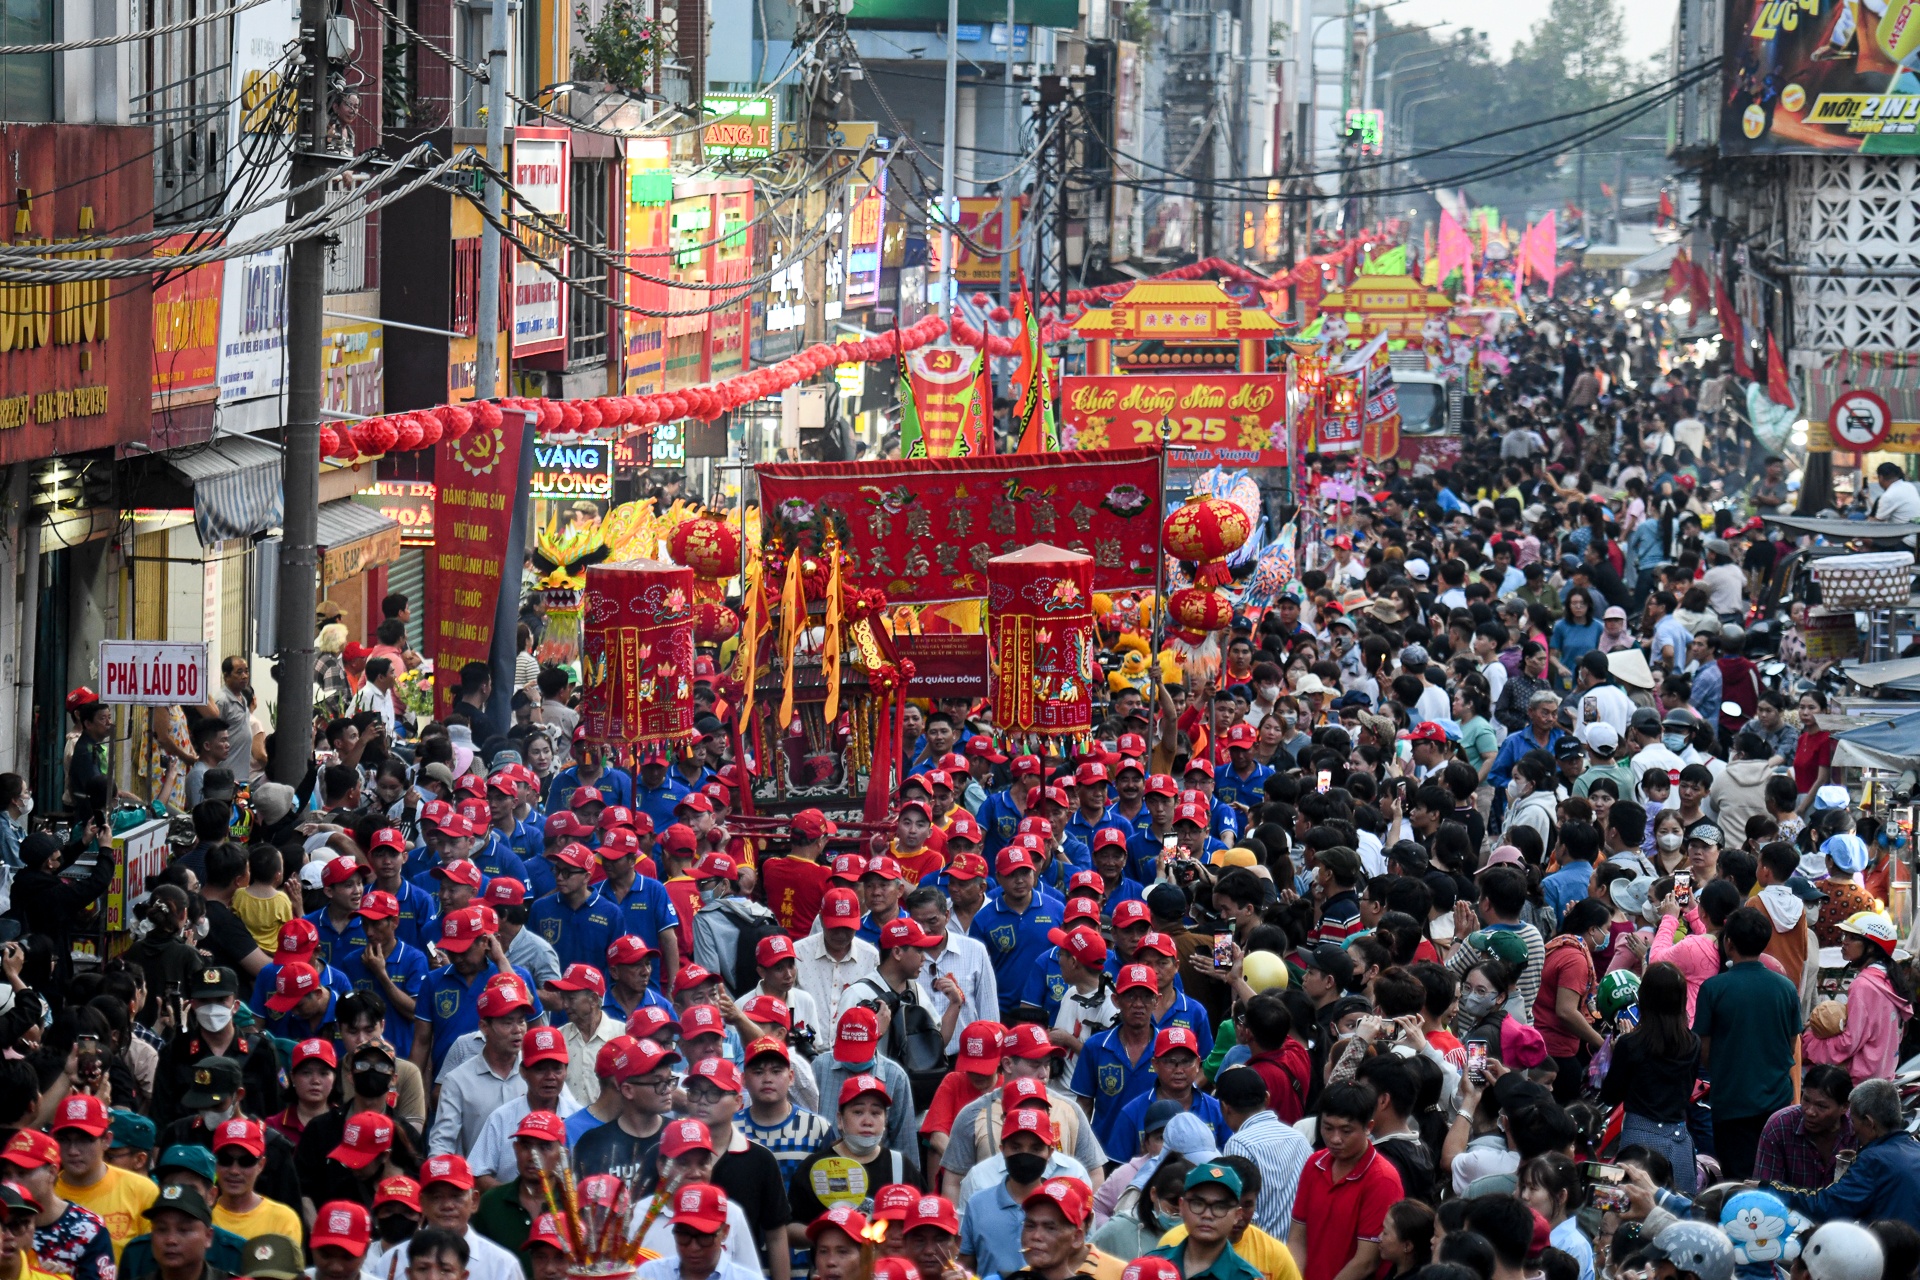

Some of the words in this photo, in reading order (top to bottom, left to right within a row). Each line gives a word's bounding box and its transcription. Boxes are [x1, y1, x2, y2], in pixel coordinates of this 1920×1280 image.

[1818, 98, 1861, 117] MỚI!
[1861, 97, 1880, 117] 2
[1878, 98, 1906, 117] IN
[1904, 98, 1920, 118] 1
[55, 206, 113, 371] MỘT
[75, 386, 109, 418] 3820397
[1071, 385, 1118, 415] Chúc
[1119, 383, 1178, 416] Mừng
[1180, 383, 1226, 411] Năm
[1228, 382, 1274, 413] Mới
[1132, 417, 1226, 444] 2025
[443, 483, 466, 506] ĐẢNG
[468, 524, 488, 542] NAM
[107, 655, 137, 695] PHÁ
[143, 651, 171, 695] LẤU
[177, 655, 198, 696] BÒ
[925, 674, 955, 685] QUẢNG
[957, 675, 982, 684] ĐÔNG
[128, 843, 142, 902] PHÁ
[667, 903, 677, 916] 5
[1611, 983, 1638, 999] Grab
